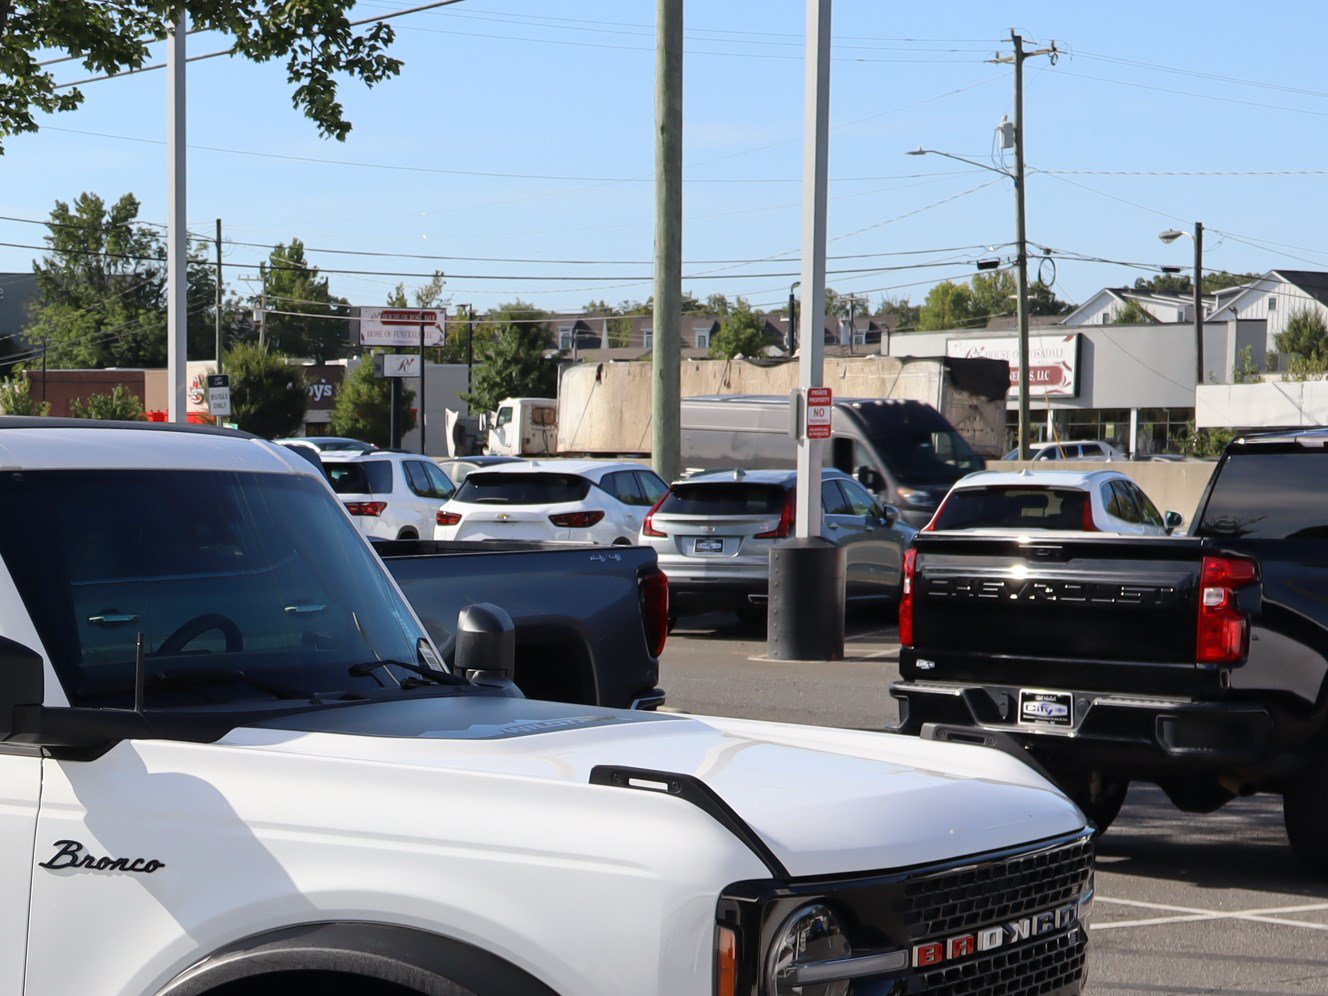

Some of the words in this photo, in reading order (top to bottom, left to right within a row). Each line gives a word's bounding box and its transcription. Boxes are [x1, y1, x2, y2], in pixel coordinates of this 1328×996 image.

[813, 408, 825, 417] NO
[928, 578, 1174, 605] CHEVROLET
[38, 839, 166, 874] Bronco
[912, 902, 1079, 968] BRONCO
